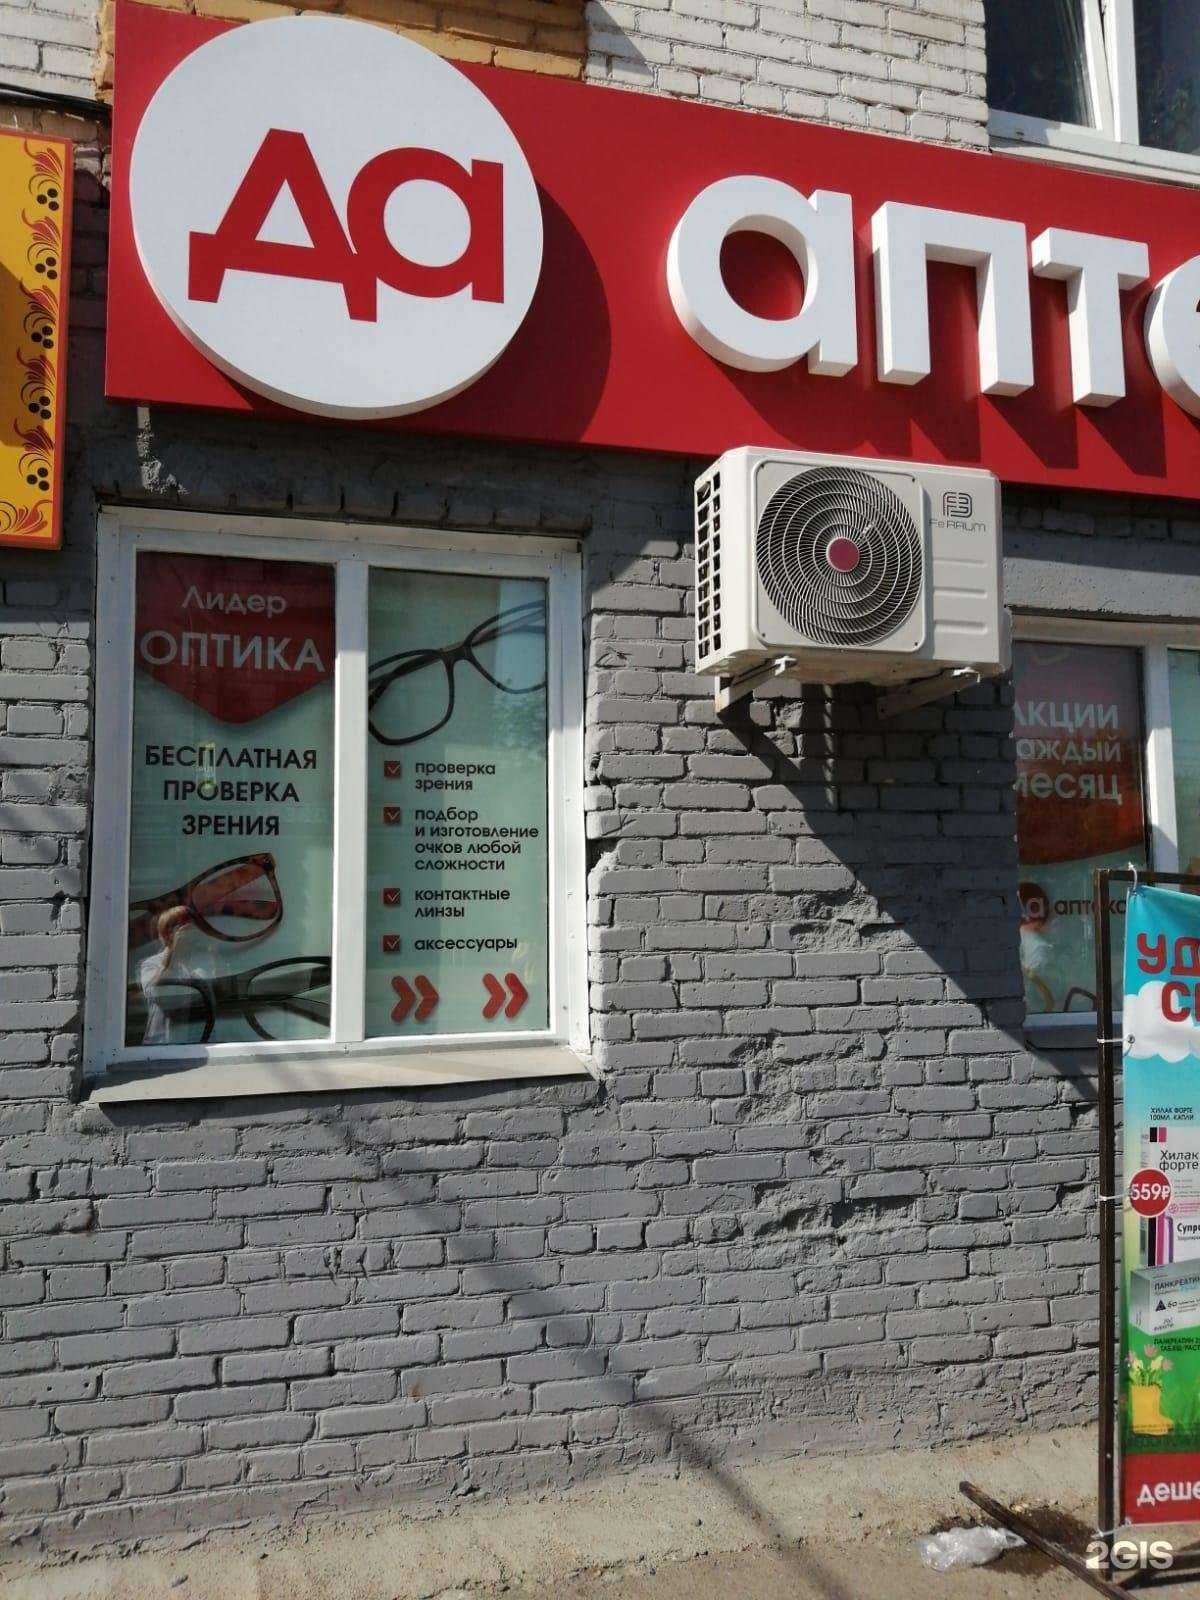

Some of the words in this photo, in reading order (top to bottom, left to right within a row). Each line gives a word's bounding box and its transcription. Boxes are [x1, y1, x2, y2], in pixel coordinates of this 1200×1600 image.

[188, 128, 504, 322] Да
[181, 585, 287, 618] Лидер
[140, 630, 326, 672] ОПТИКА
[145, 745, 317, 769] БЕСПЛАТНАЯ
[1016, 735, 1121, 765] аждый
[415, 762, 496, 776] проверка
[164, 780, 300, 802] ПРОВЕРКА
[415, 779, 473, 792] зрения
[415, 807, 478, 823] подбор
[182, 814, 279, 836] ЗРЕНИЯ
[415, 827, 425, 837] и
[430, 826, 539, 838] изготовление
[415, 843, 463, 854] очков
[467, 841, 521, 854] любой
[415, 859, 505, 871] сложности
[415, 889, 511, 901] контактные
[415, 907, 465, 918] линзы
[415, 938, 518, 952] аксессуары
[1161, 981, 1200, 1022] С
[1160, 1150, 1199, 1160] Хилак
[1159, 1160, 1199, 1173] форте
